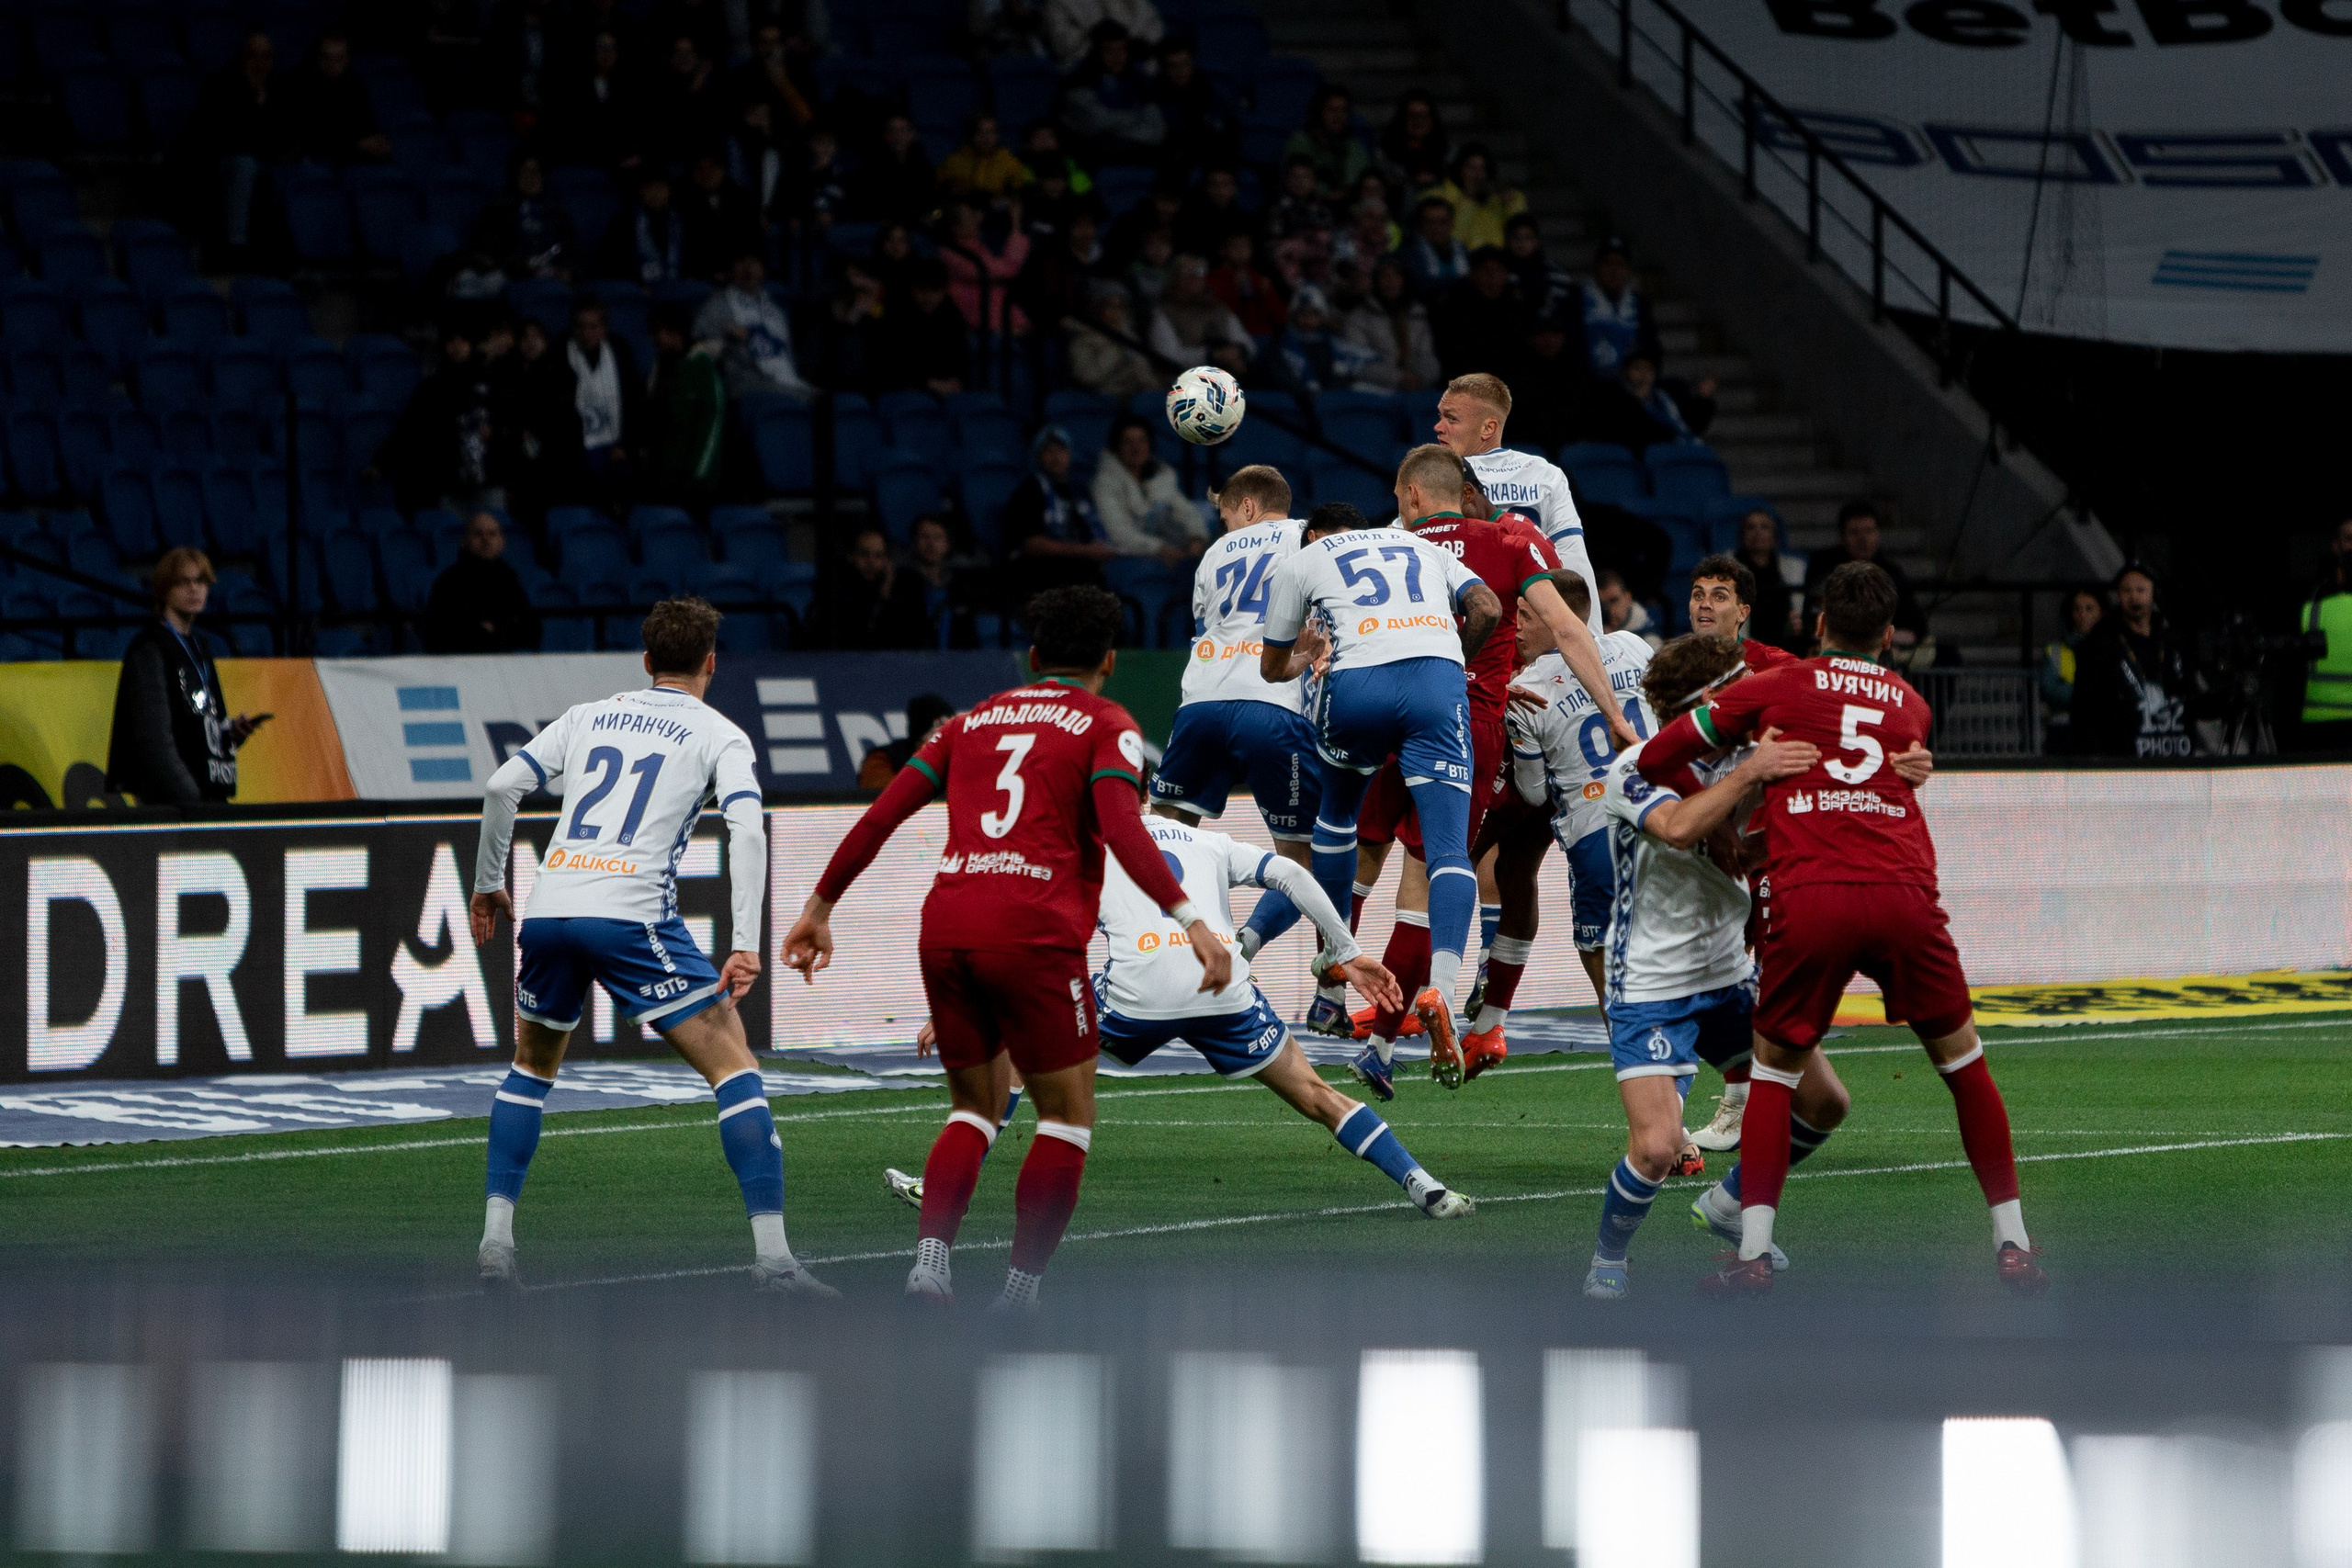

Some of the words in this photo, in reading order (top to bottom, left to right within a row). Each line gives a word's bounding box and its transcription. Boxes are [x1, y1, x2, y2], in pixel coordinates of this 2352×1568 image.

[1226, 531, 1283, 553] ФОМН
[1414, 524, 1460, 536] ONBET
[1216, 553, 1276, 625] 74
[1335, 546, 1425, 606] 57
[1830, 658, 1887, 677] FONBET
[1556, 668, 1642, 718] ГЛАШЕВ
[1814, 670, 1904, 708] ВУЯЧИЧ
[592, 713, 693, 746] МИРАНЧУК
[963, 704, 1093, 735] МАЛЬДОНАДО
[1824, 704, 1884, 784] 5
[2134, 736, 2192, 758] PHOTO
[980, 733, 1036, 840] 3
[1289, 752, 1299, 807] BetBoom
[1449, 763, 1469, 781] ВТБ
[566, 745, 667, 847] 21
[1157, 780, 1184, 795] ВТБ
[1818, 790, 1882, 803] КАЗАНЬ
[1270, 814, 1297, 828] ВТБ
[1818, 801, 1906, 818] ОРГСИНТЕЗ
[27, 837, 722, 1072] DREA
[653, 977, 689, 999] ВТБ
[1258, 1025, 1279, 1052] ВТБ
